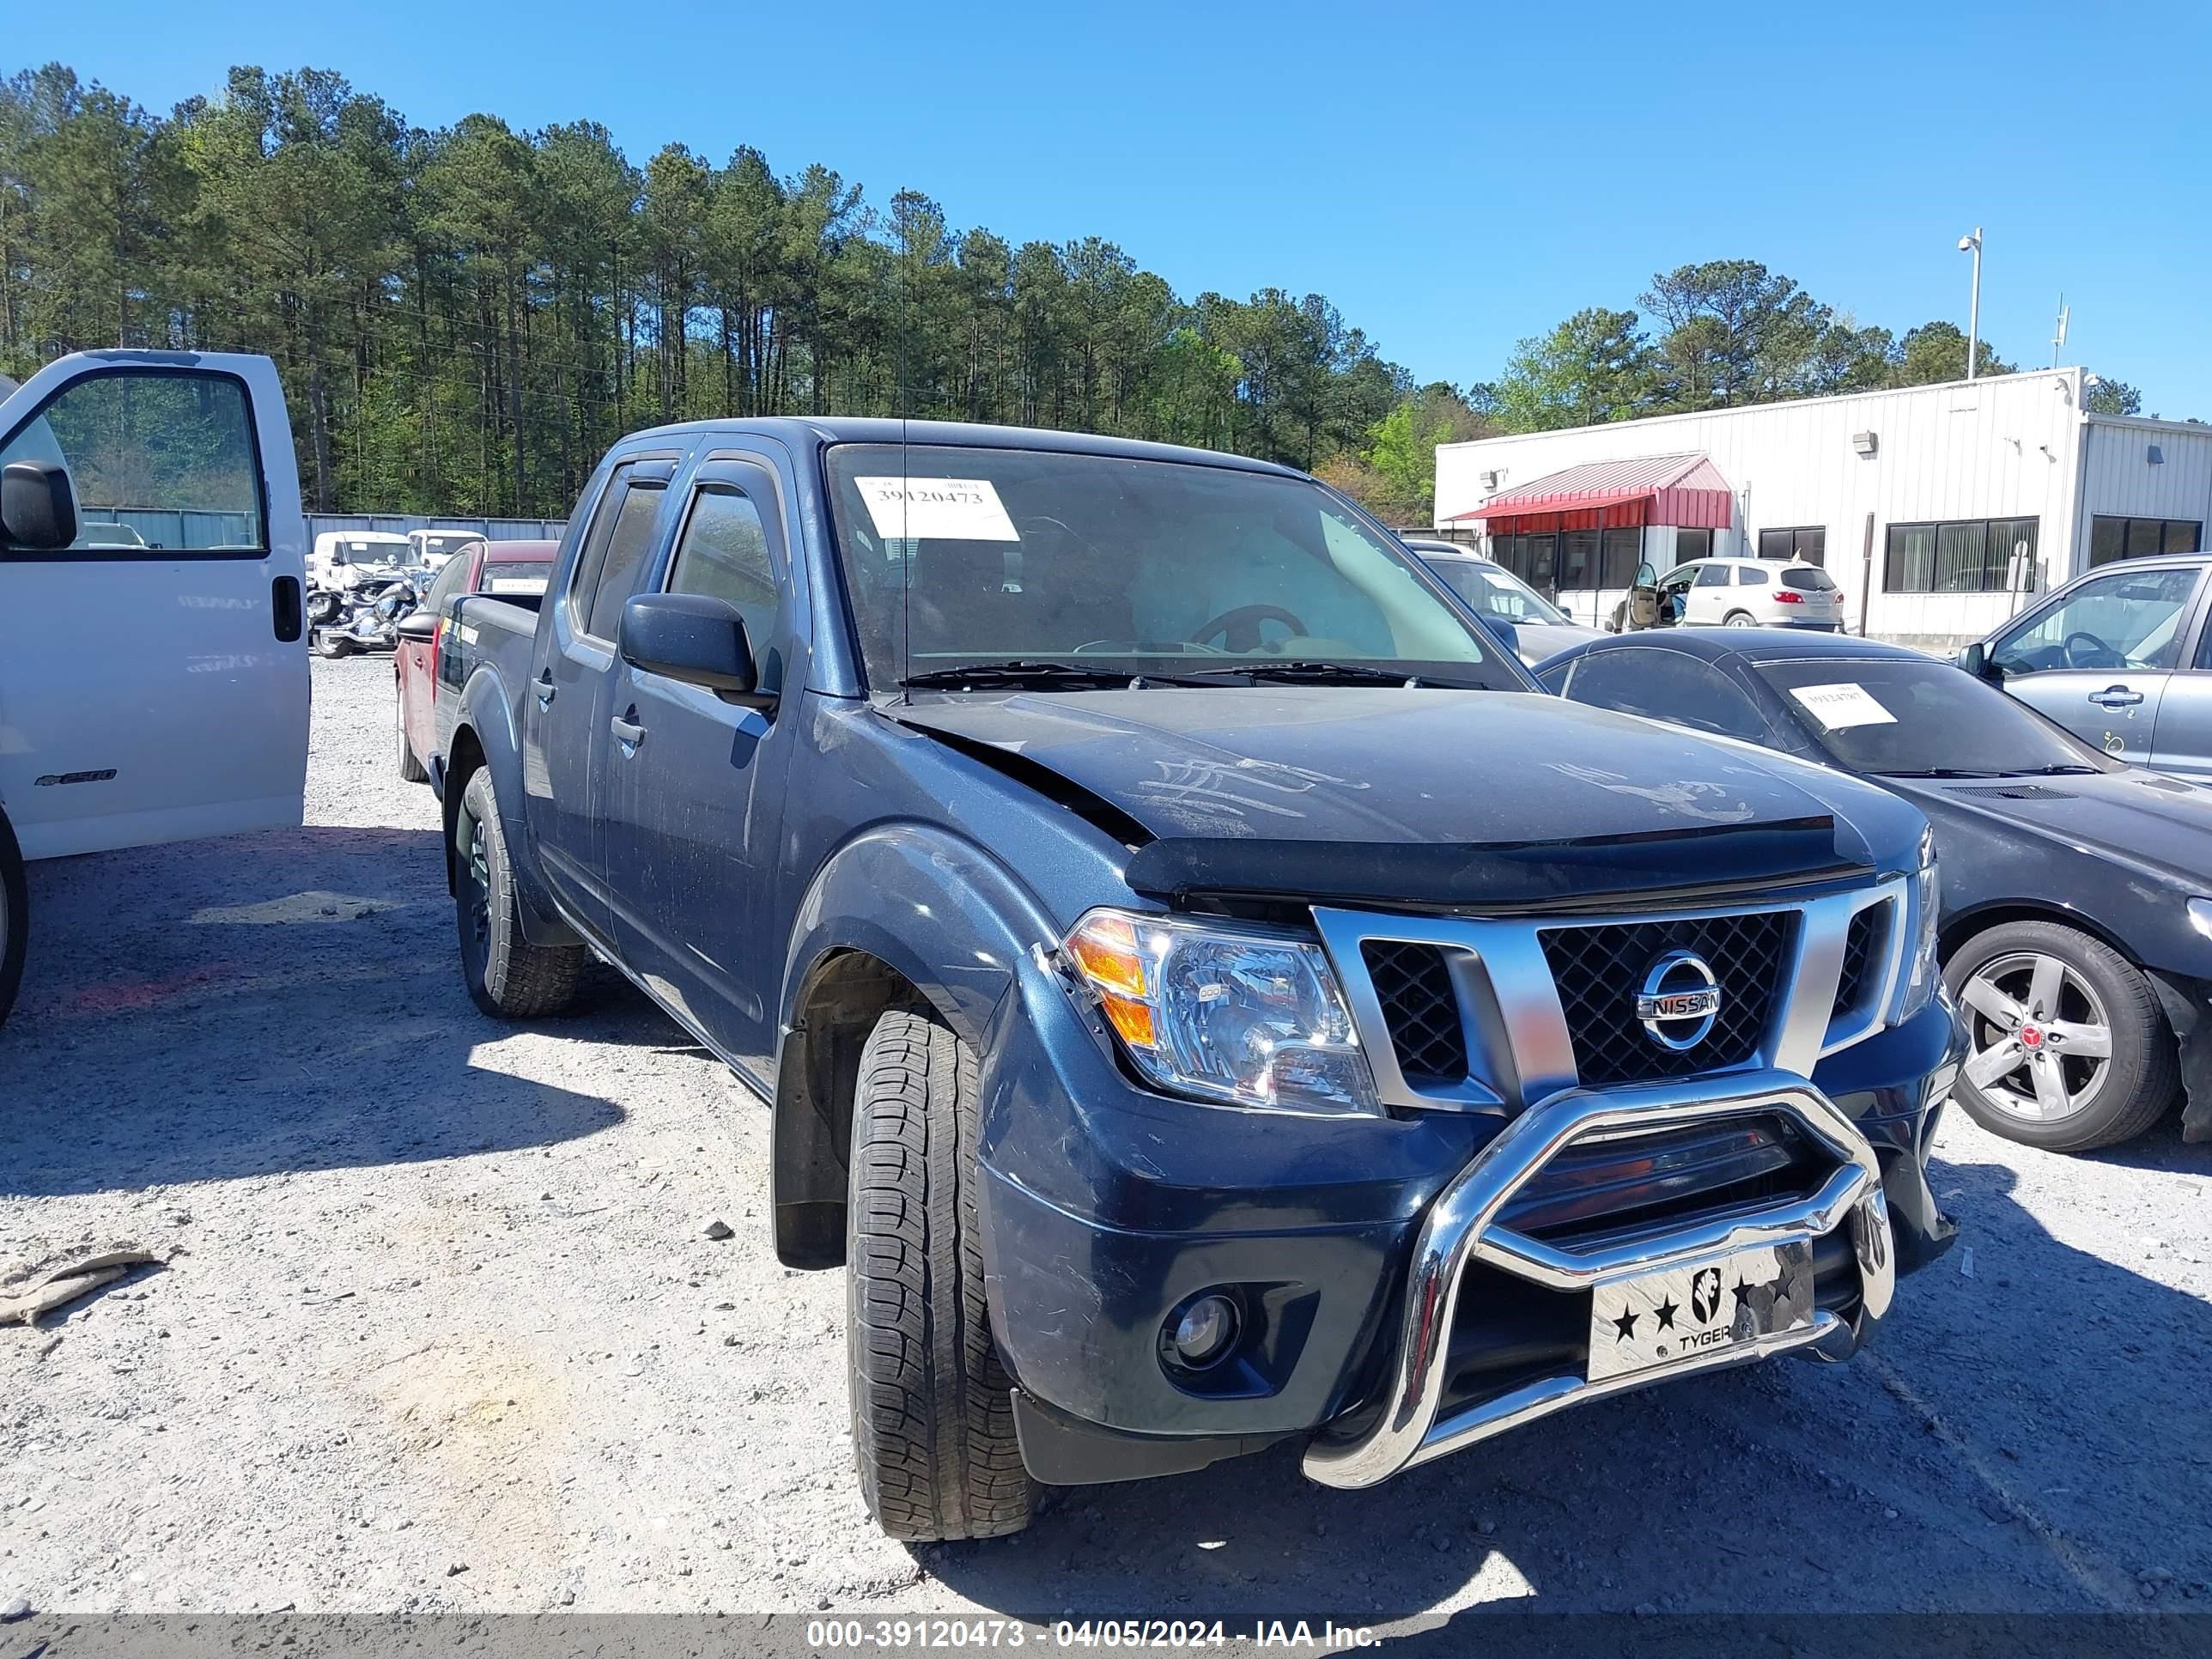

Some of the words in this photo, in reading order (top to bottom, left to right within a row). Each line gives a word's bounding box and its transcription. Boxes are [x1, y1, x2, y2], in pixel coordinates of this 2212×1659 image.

[878, 489, 983, 505] 39120473
[1652, 994, 1719, 1015] NISSAN
[1679, 1325, 1732, 1352] TYGER
